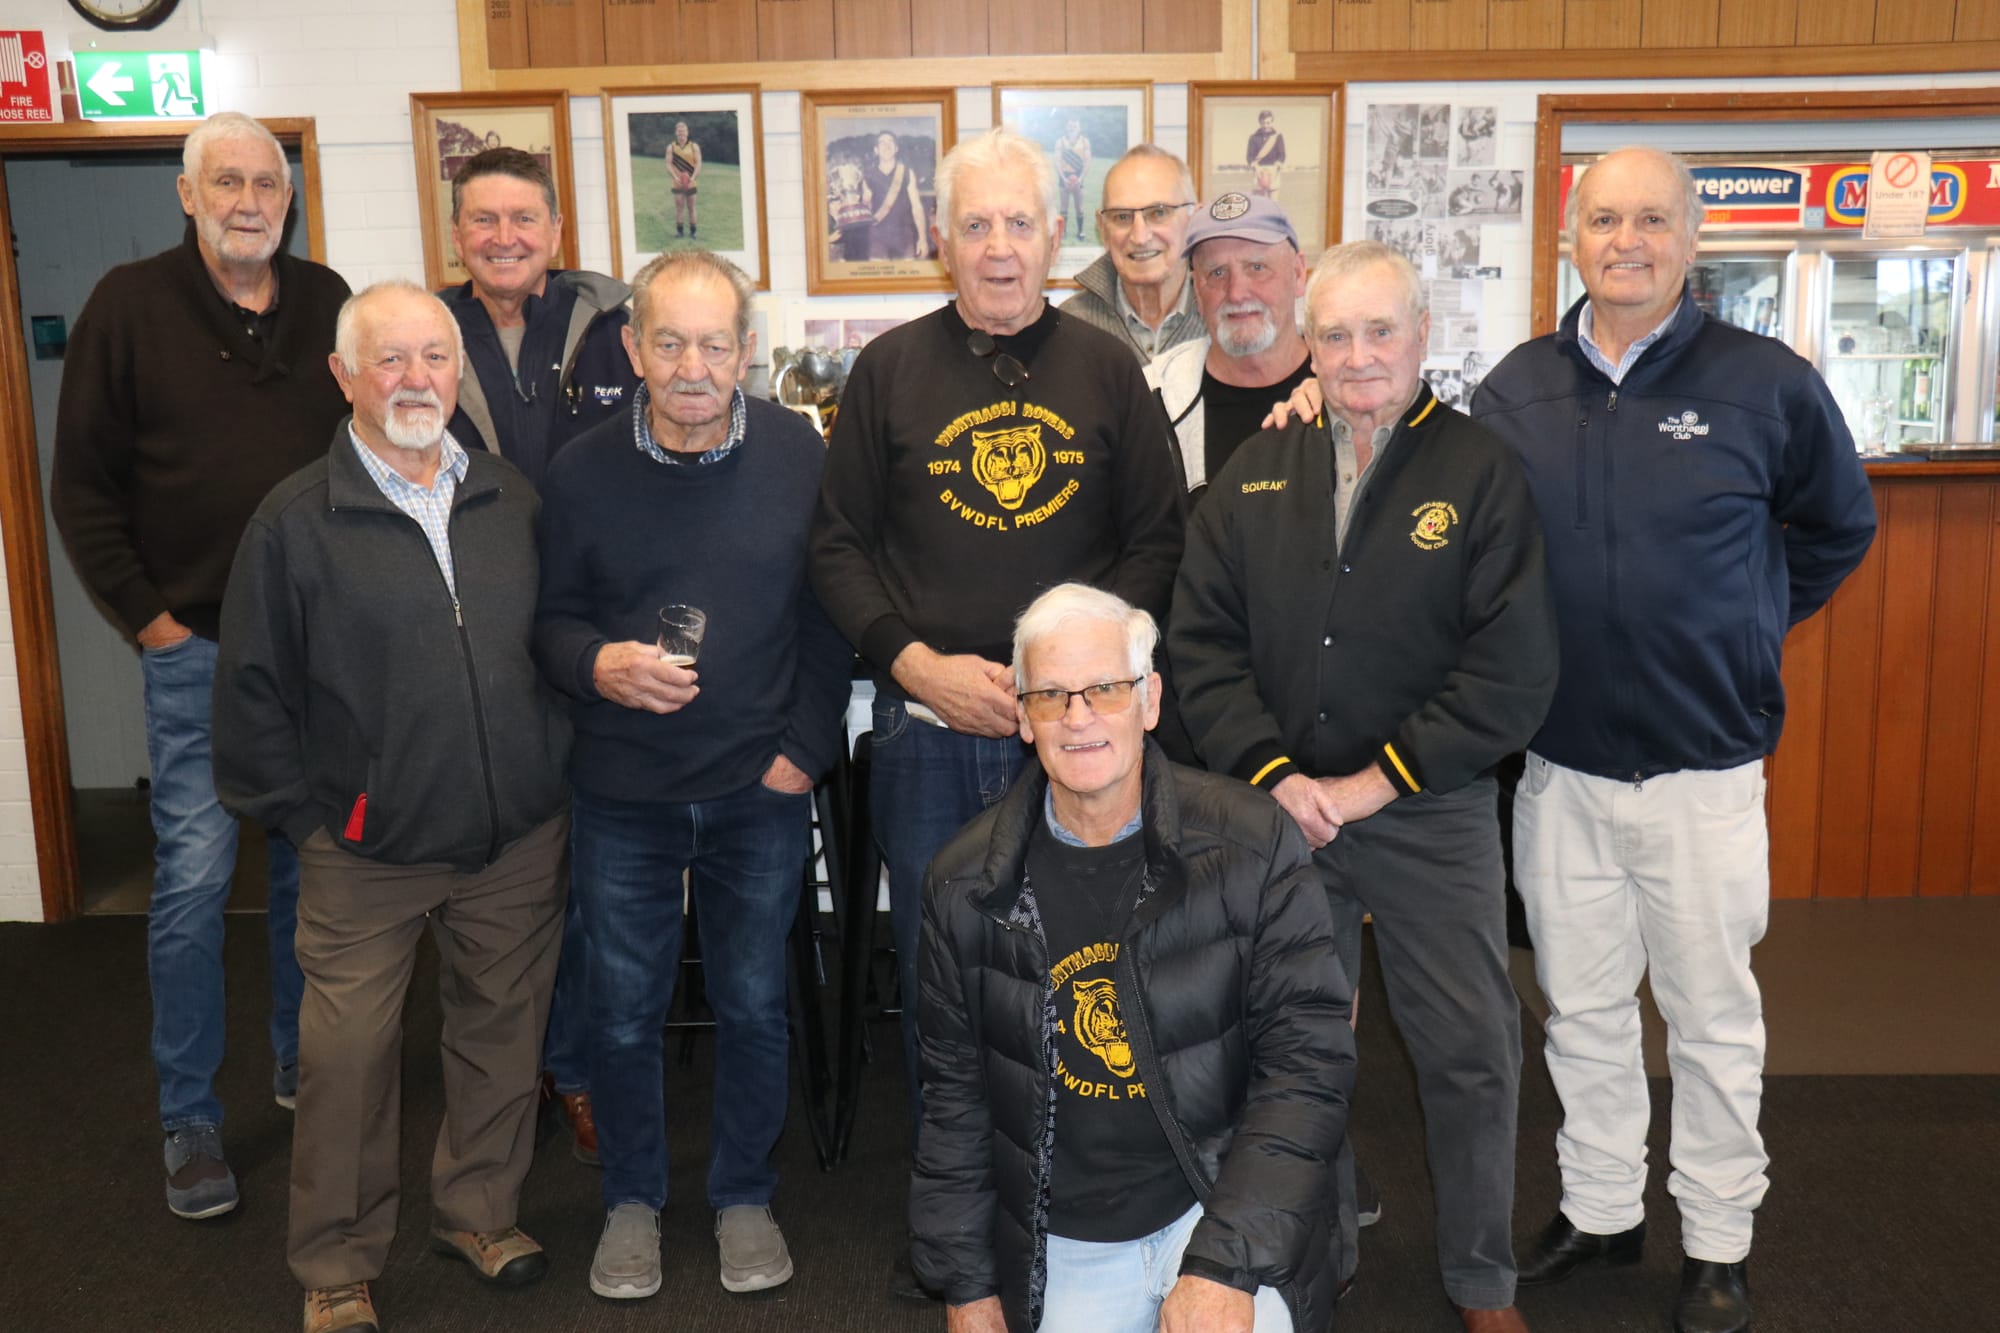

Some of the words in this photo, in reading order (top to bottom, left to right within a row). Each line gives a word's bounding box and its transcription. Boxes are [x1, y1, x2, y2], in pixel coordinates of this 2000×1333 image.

[10, 96, 33, 107] FIRE
[26, 108, 51, 120] REEL
[1423, 224, 1436, 256] glory
[934, 401, 1016, 447] WONTHAGGI
[1022, 403, 1075, 440] ROVERS
[1658, 421, 1709, 435] Wonthaggi
[1673, 432, 1692, 440] Club
[1053, 451, 1085, 465] 1975
[927, 460, 961, 475] 1974
[1241, 480, 1288, 494] SQUEAKY
[939, 489, 1008, 531] BVWDFL
[1015, 478, 1080, 529] PREMIERS
[1057, 1060, 1120, 1100] VWDFL
